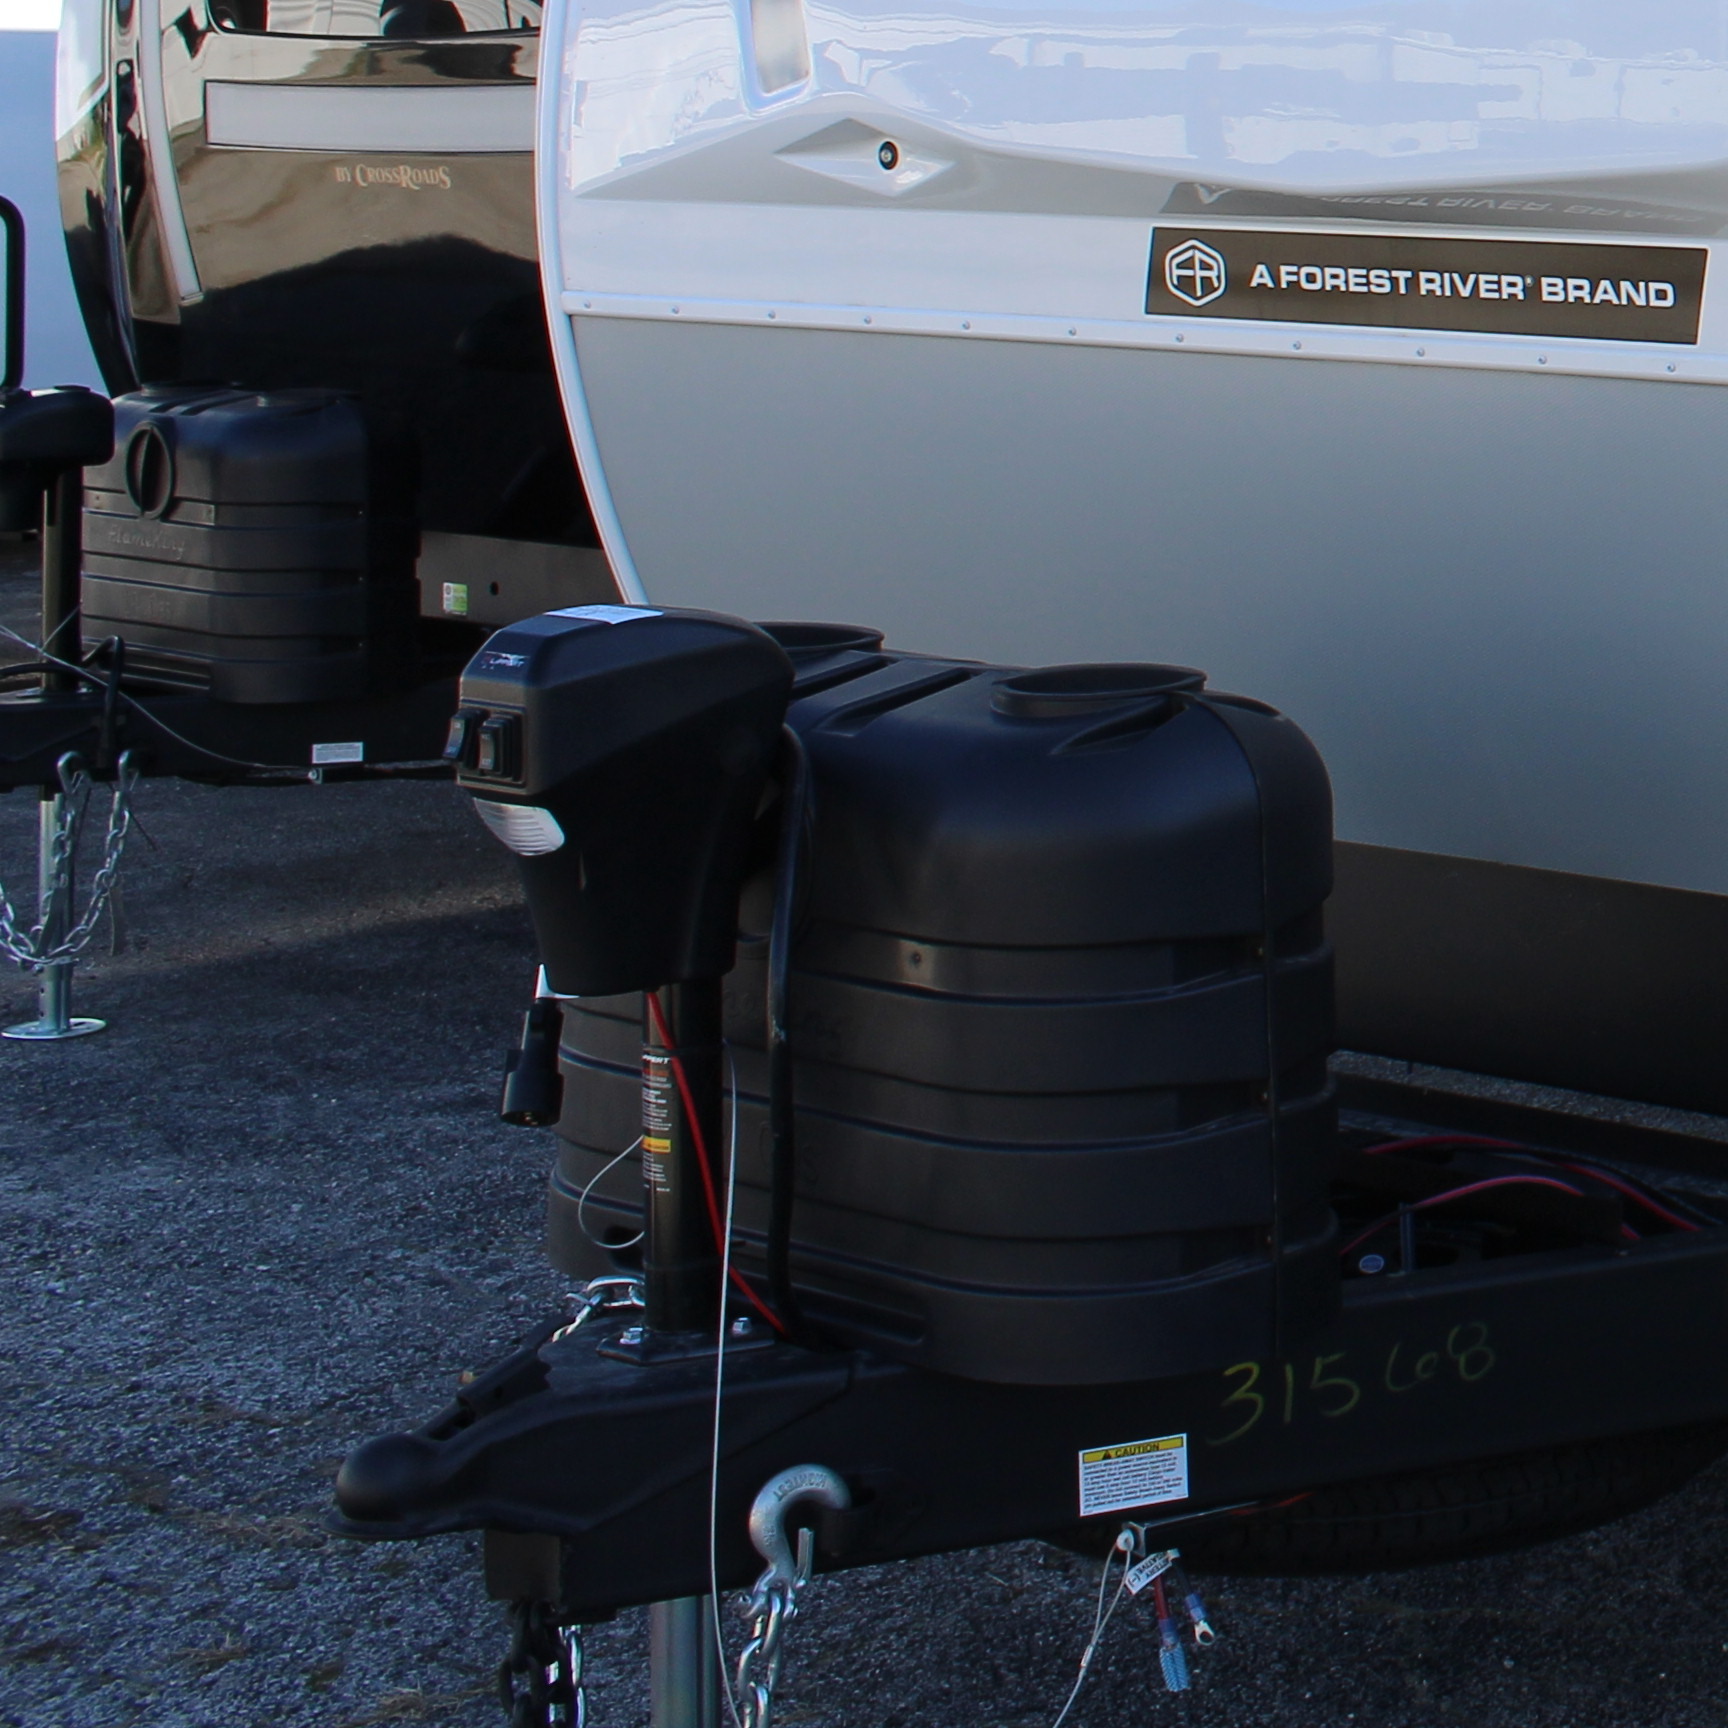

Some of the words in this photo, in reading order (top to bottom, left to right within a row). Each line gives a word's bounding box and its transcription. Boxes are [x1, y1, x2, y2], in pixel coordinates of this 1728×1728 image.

[334, 166, 352, 183] BY
[1249, 263, 1275, 289] A
[1280, 264, 1415, 296] FOREST
[1540, 276, 1676, 309] BRAND
[1115, 1442, 1160, 1458] CAUTION
